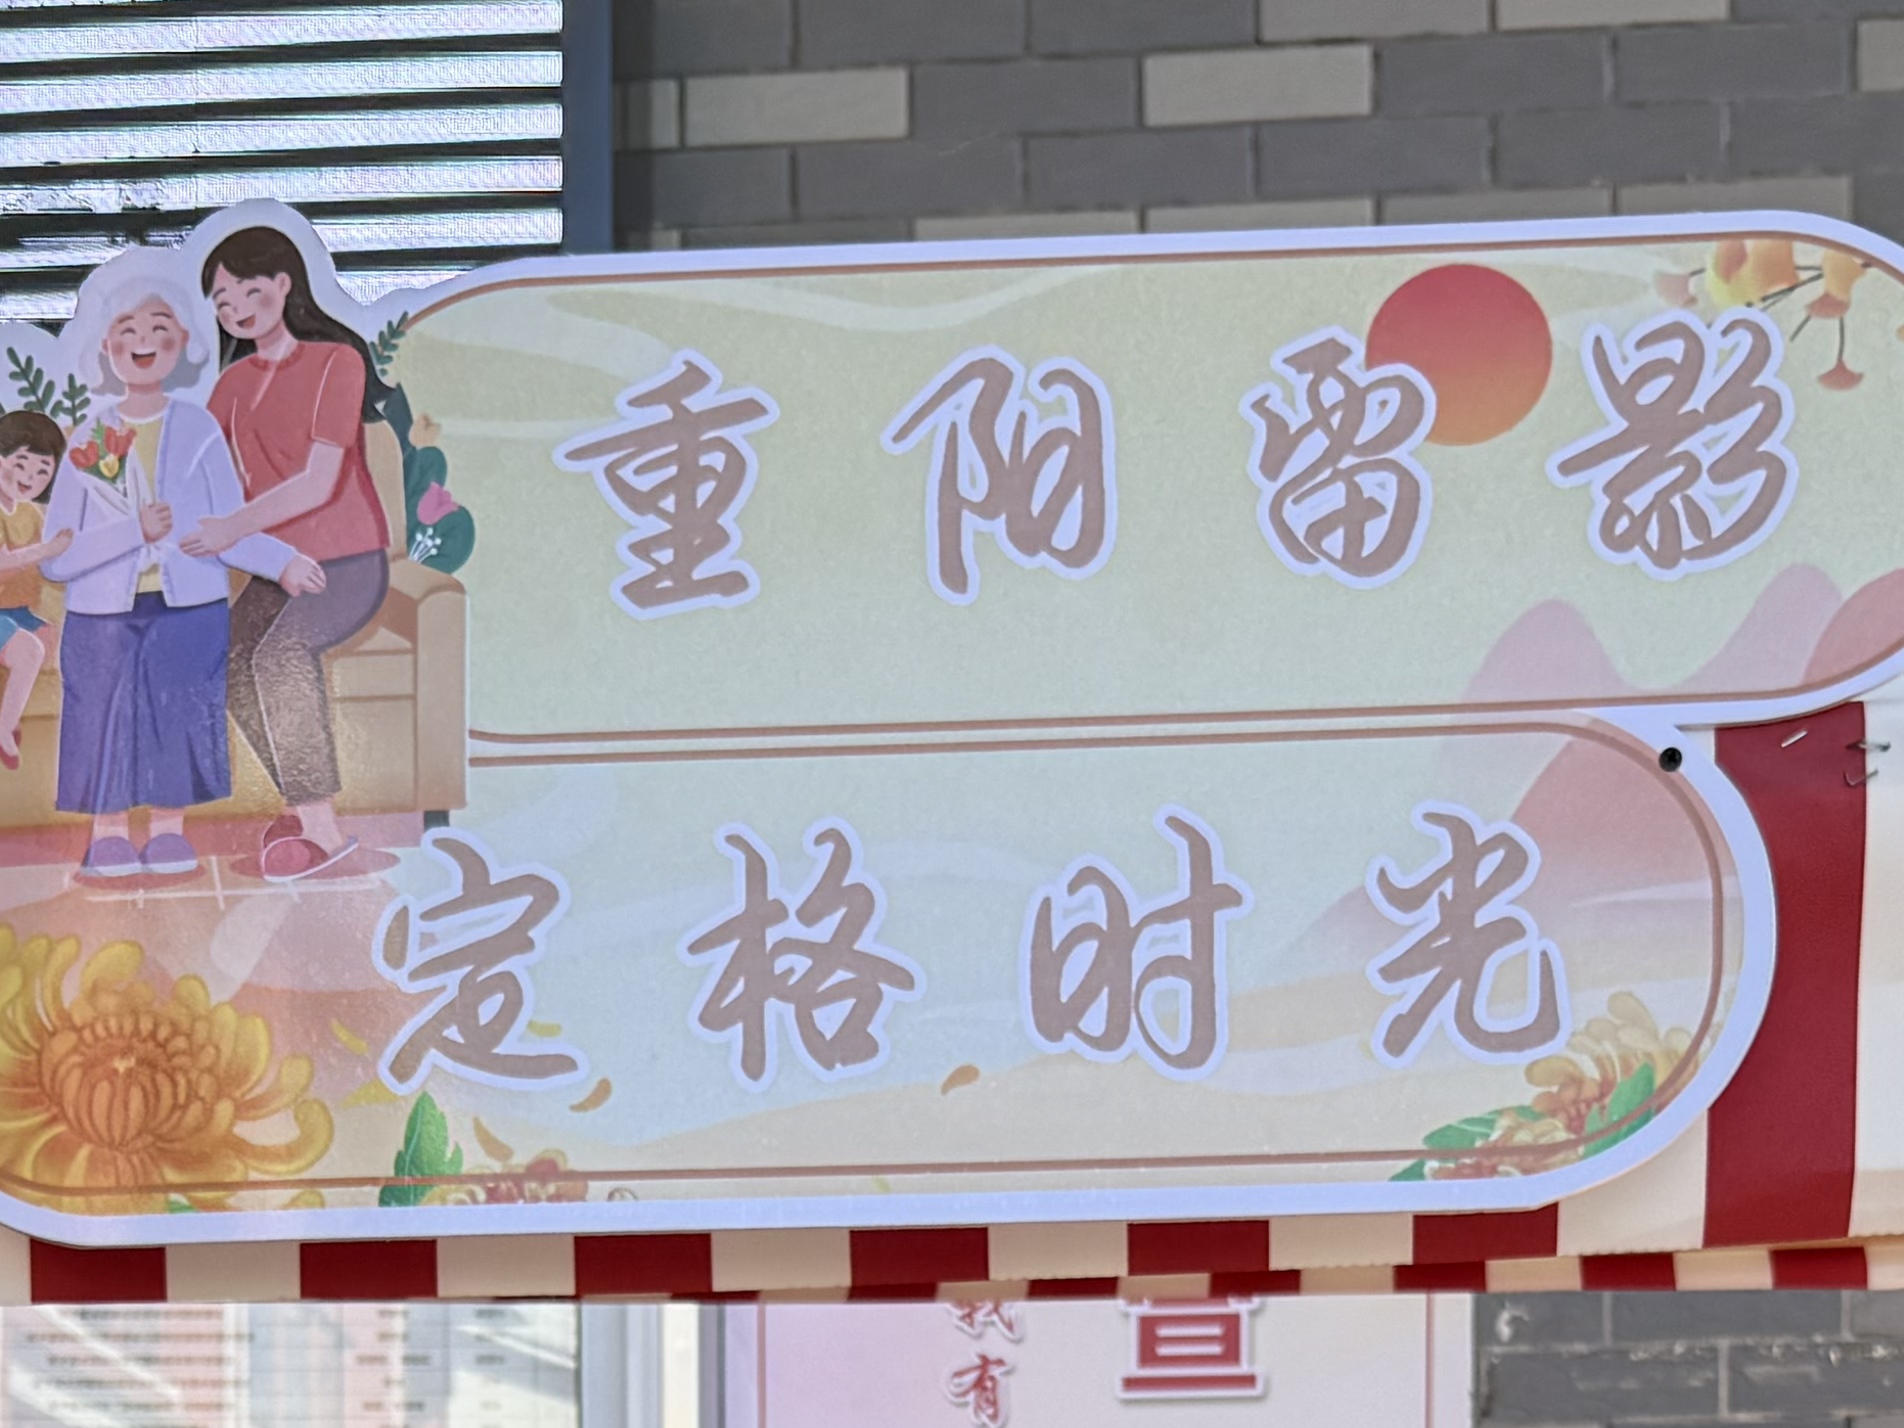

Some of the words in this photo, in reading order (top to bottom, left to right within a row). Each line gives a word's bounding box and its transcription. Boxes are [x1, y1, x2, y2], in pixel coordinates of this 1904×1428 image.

[562, 308, 1794, 614] 重阳留影
[381, 808, 1566, 1090] 定格时光
